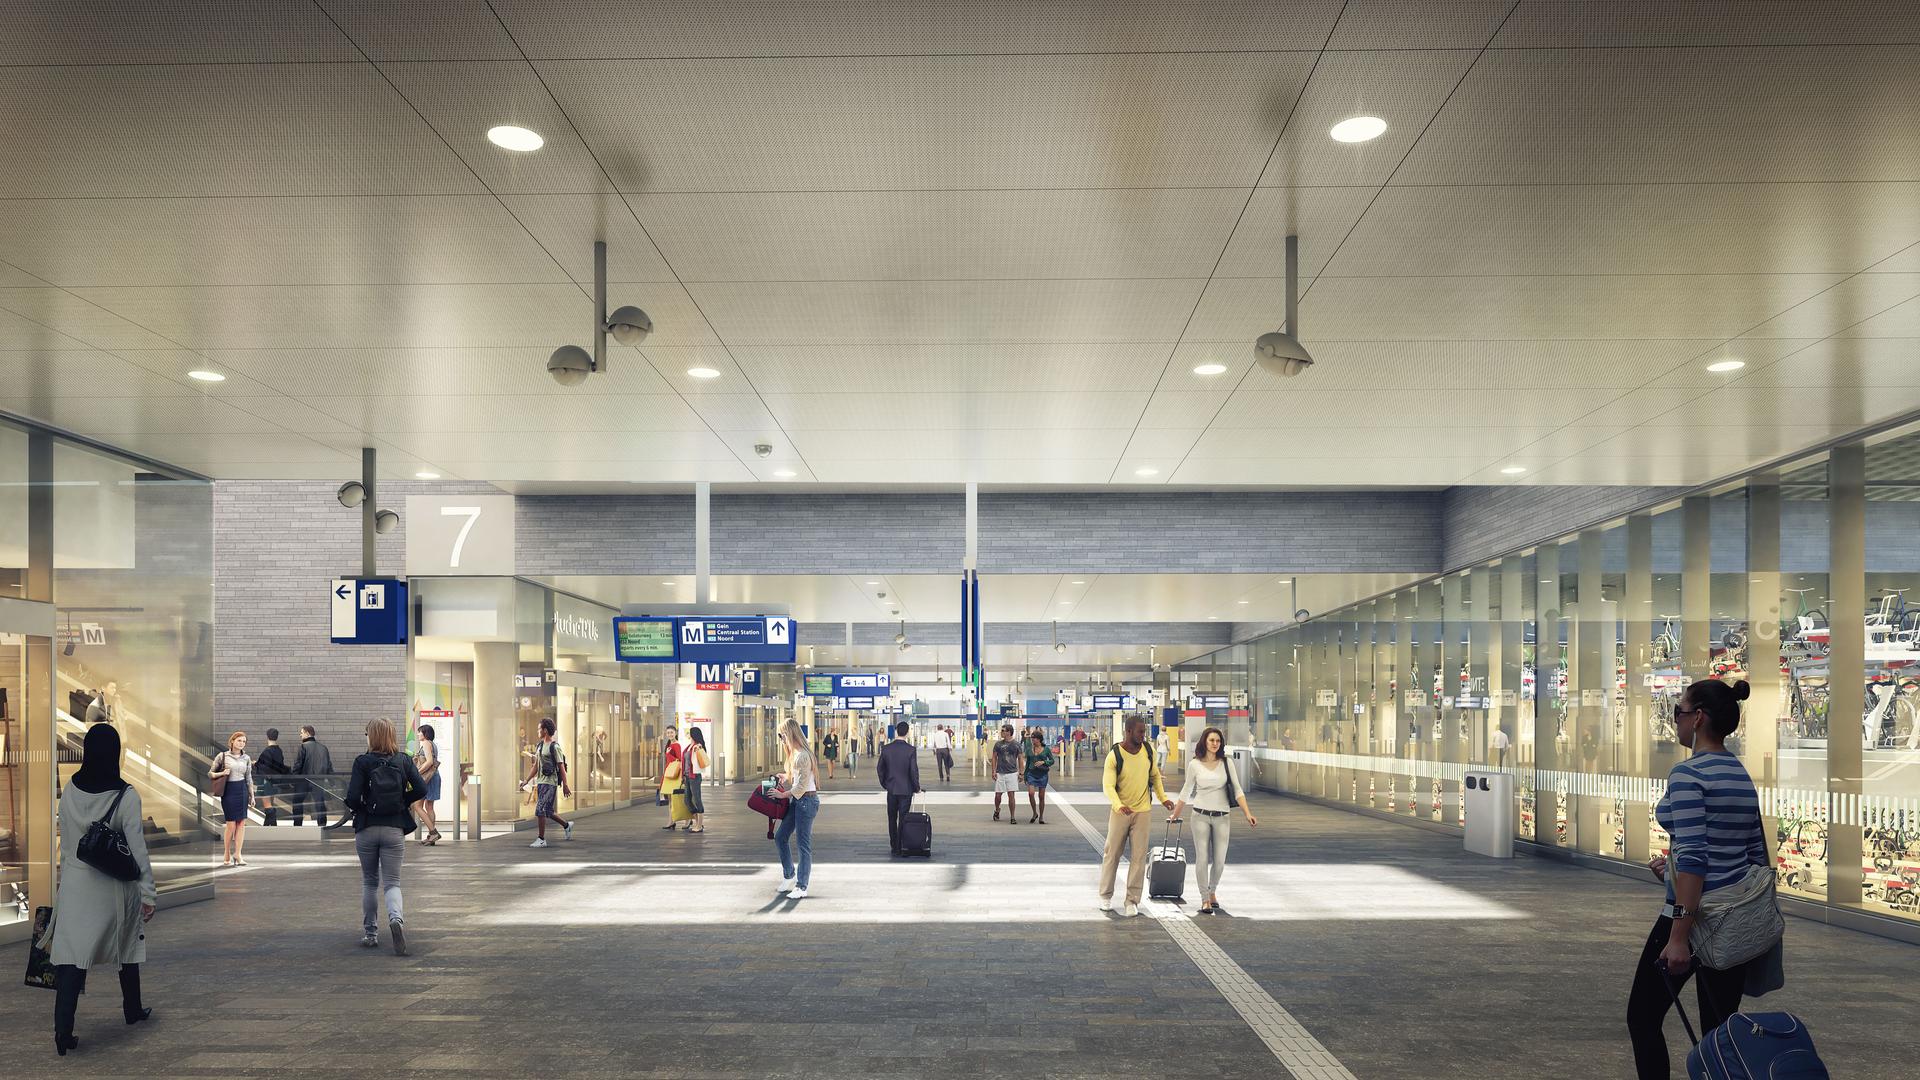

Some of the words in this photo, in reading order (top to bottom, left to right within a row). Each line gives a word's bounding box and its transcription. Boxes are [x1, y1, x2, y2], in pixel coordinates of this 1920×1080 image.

[441, 507, 481, 567] 7
[685, 628, 701, 642] M
[701, 664, 719, 682] M
